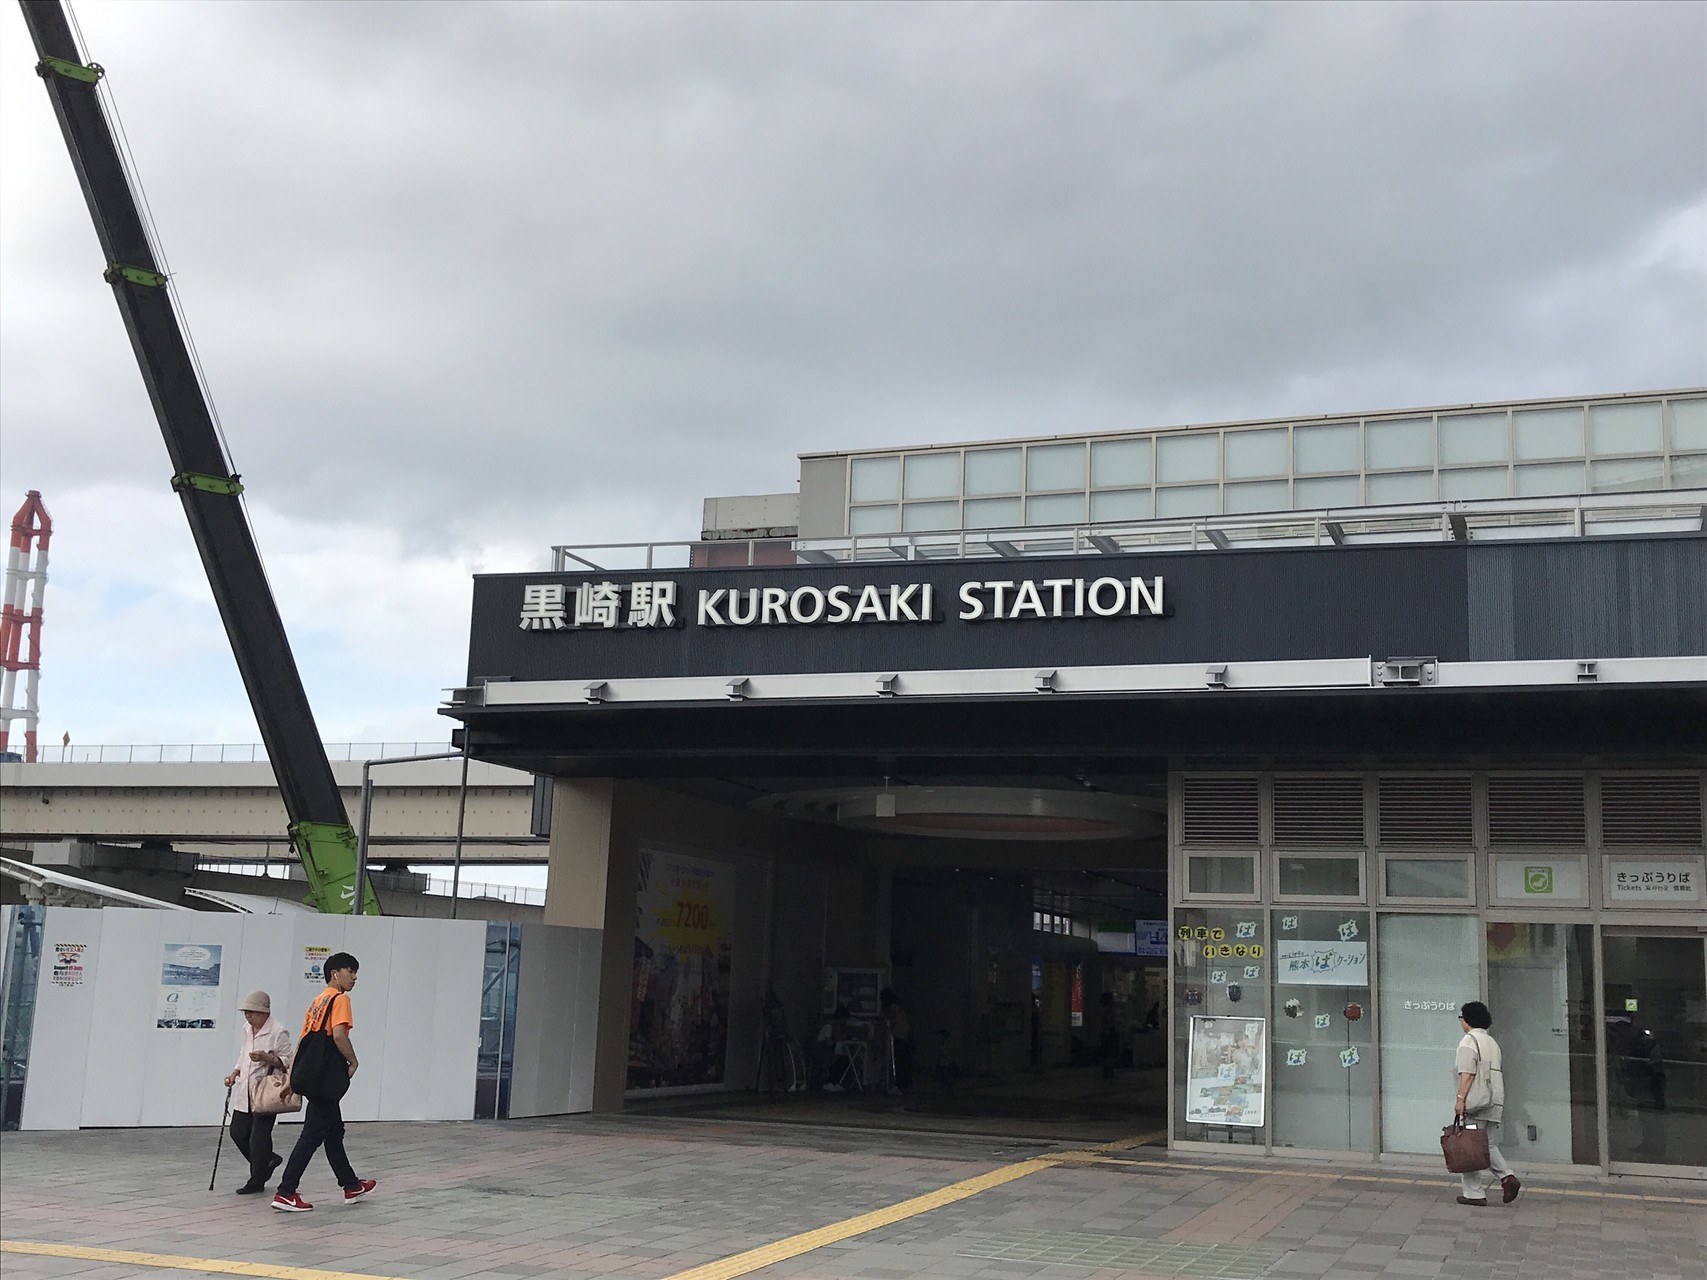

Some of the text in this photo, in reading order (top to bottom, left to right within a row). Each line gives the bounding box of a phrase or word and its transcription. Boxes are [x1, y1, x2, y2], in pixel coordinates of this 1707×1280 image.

[519, 575, 1165, 630] 黒崎駅 KUROSAKI STATION
[1617, 872, 1690, 883] きっぷうりば
[676, 901, 709, 929] 7200
[1179, 927, 1223, 940] 列車で
[1204, 945, 1262, 957] いきなり
[1404, 1000, 1456, 1010] きっぷうりば
